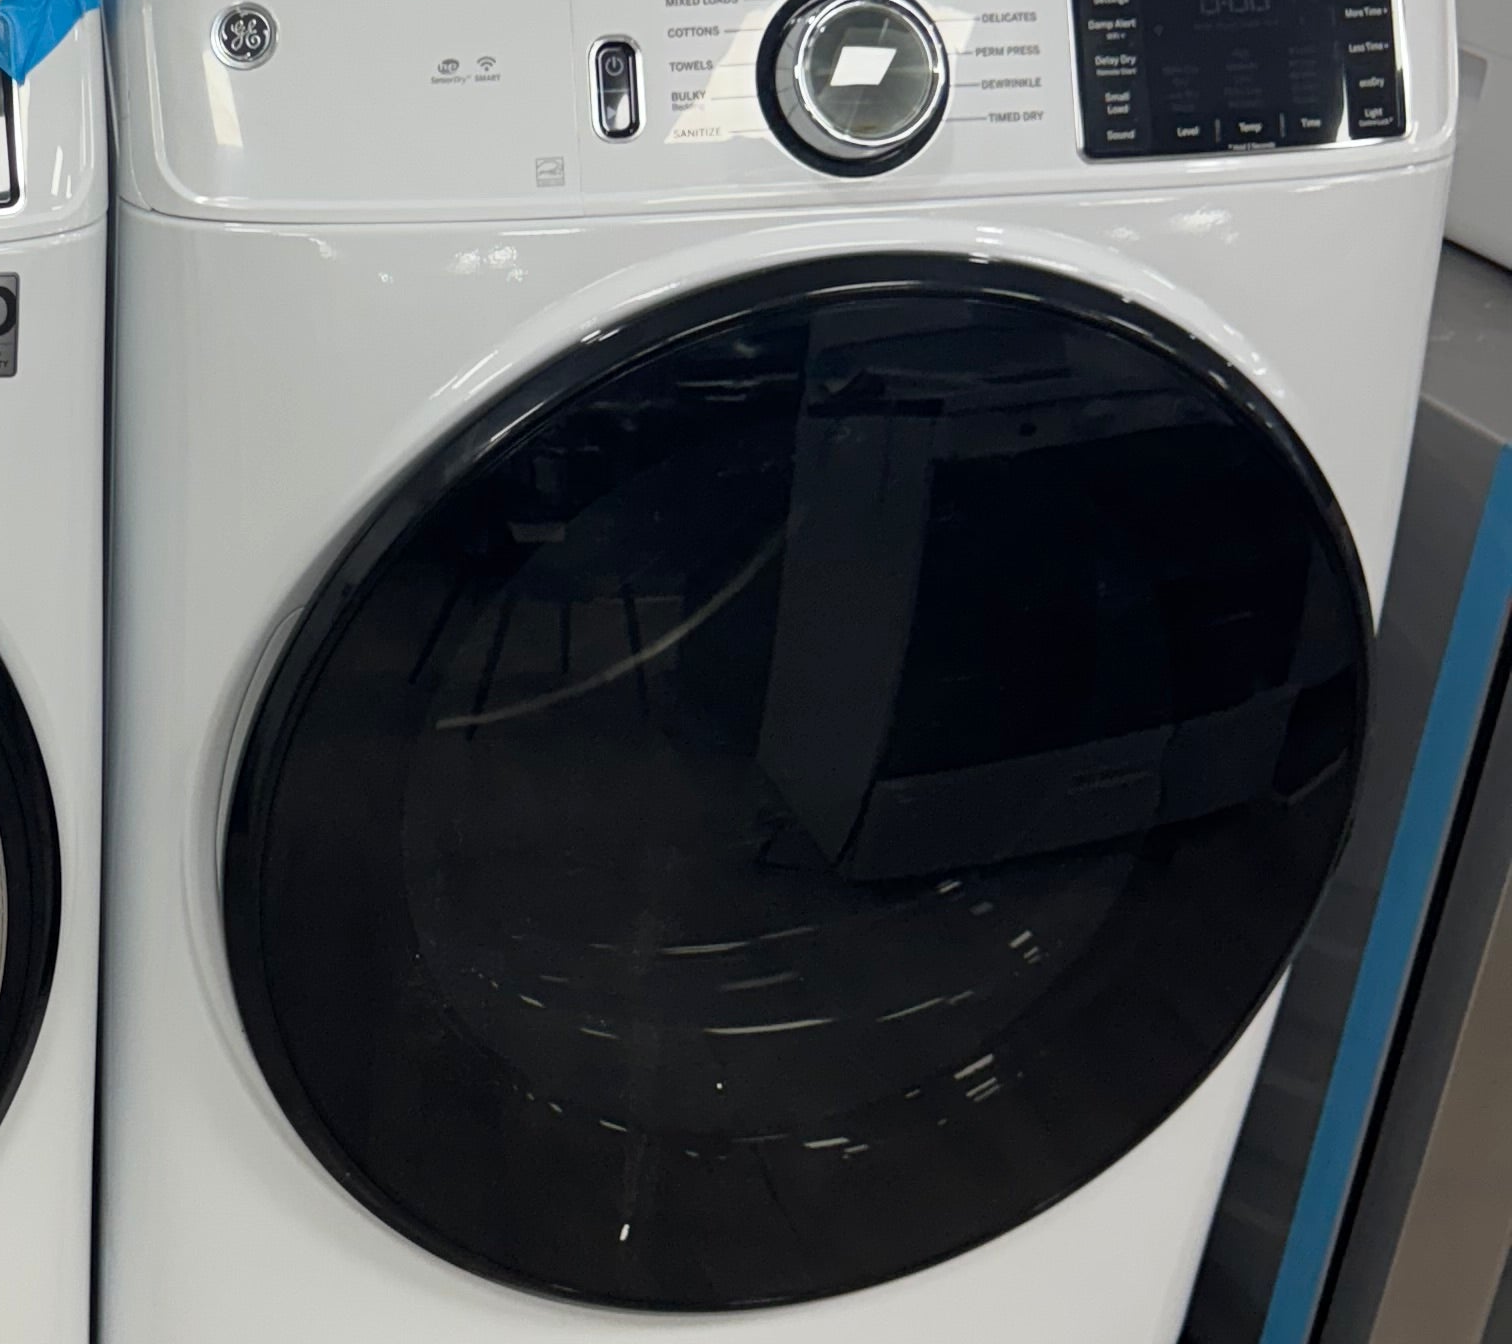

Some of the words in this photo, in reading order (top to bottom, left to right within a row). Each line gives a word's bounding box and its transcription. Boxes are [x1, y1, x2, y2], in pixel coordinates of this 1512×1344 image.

[981, 11, 1037, 23] DELICATES
[667, 26, 720, 38] COTTONS
[975, 46, 1004, 57] PERM
[1007, 45, 1040, 56] PRESS
[669, 60, 713, 72] TOWELS
[474, 74, 501, 82] SMART
[981, 77, 1042, 89] DEWRINKLE
[671, 91, 706, 102] BULKY
[988, 112, 1021, 123] TIMED
[1023, 111, 1044, 121] DRY
[1299, 117, 1322, 129] Time
[673, 127, 721, 138] SANITIZE
[1177, 125, 1200, 138] Level
[1238, 122, 1264, 134] Temp
